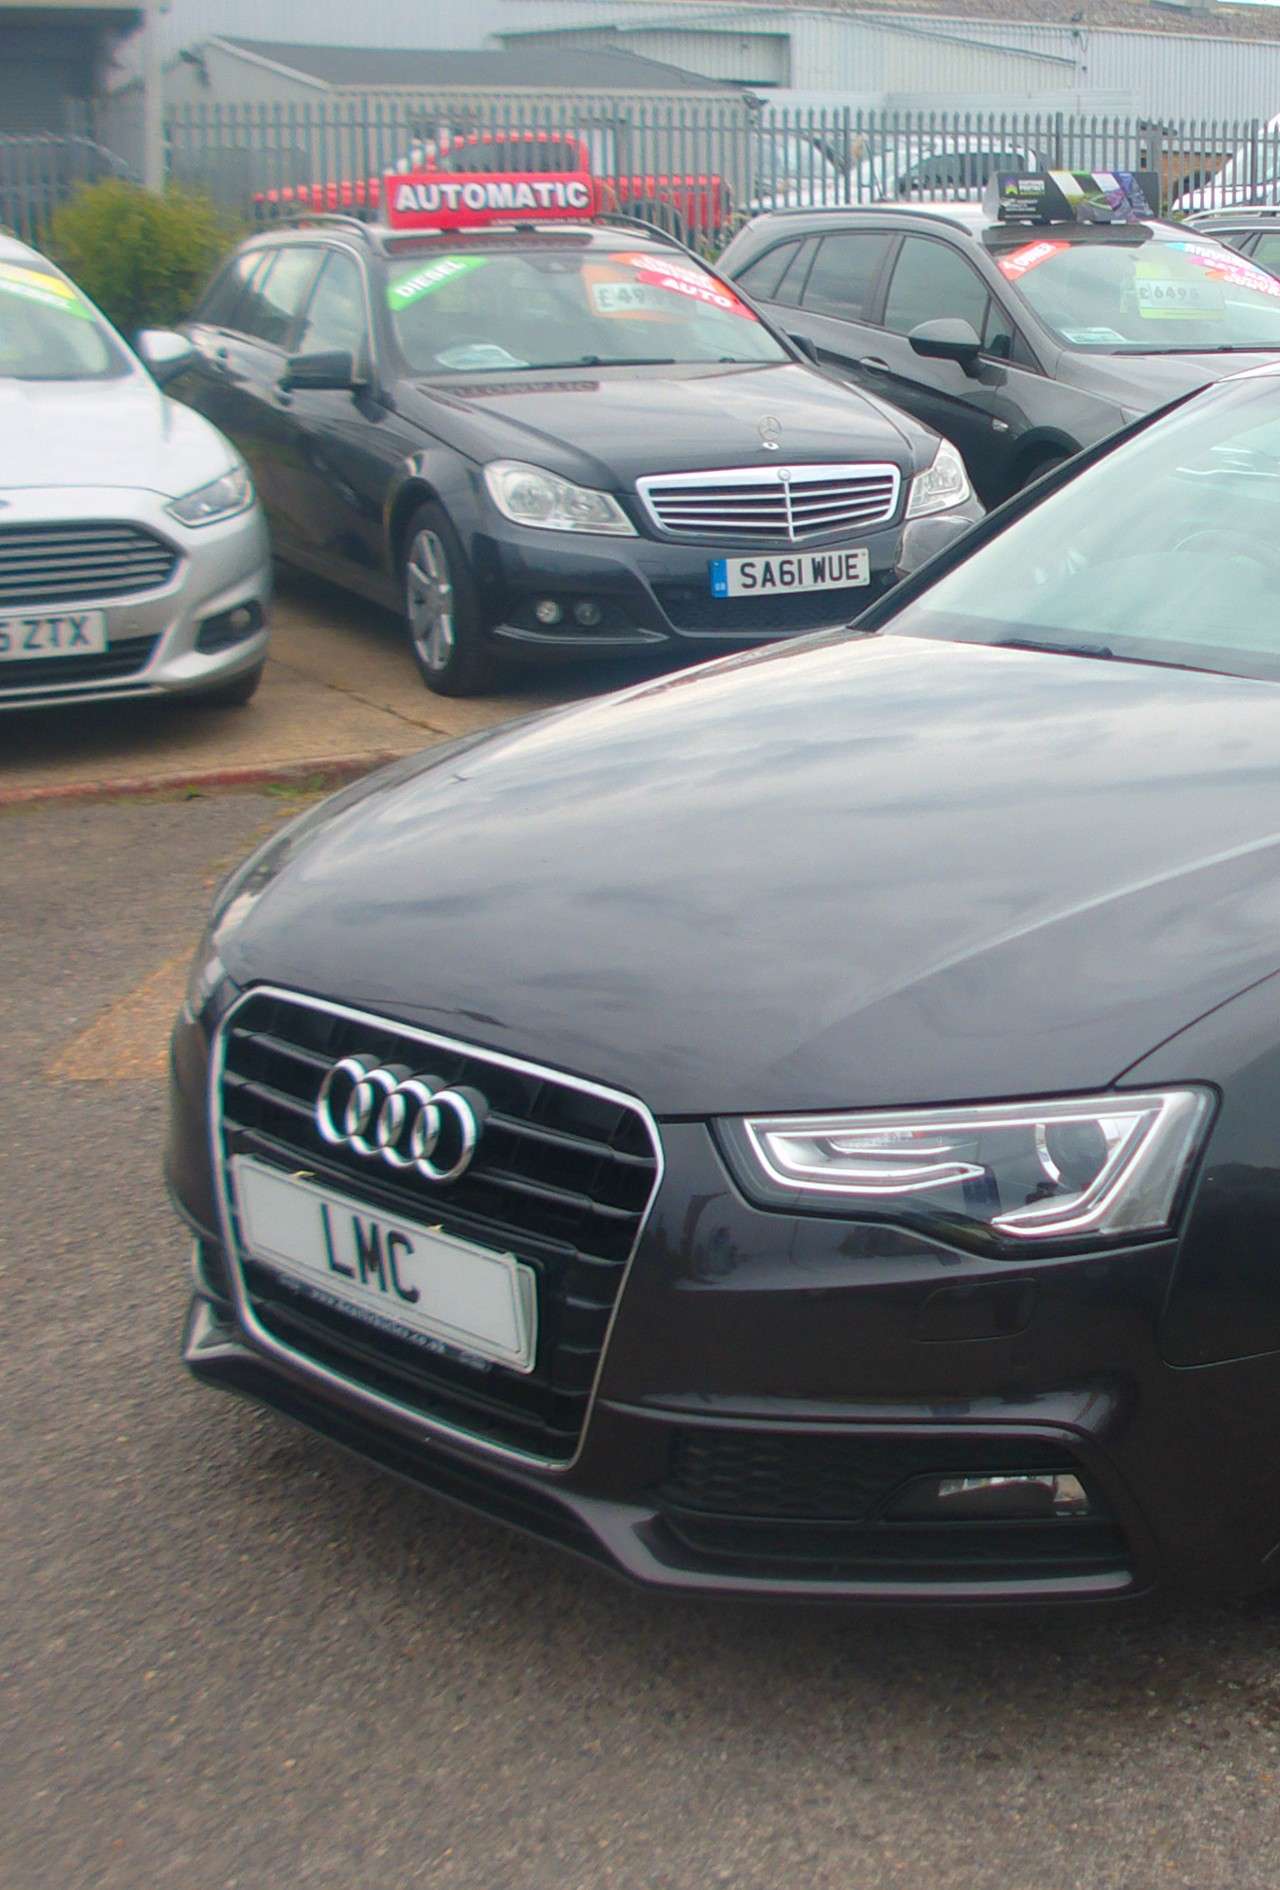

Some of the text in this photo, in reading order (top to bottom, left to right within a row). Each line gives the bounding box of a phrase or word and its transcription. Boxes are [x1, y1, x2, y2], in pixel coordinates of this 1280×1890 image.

[395, 181, 589, 211] AUTOMATIC
[662, 279, 733, 308] AUTO
[739, 553, 860, 590] SA61 WUE
[21, 615, 91, 651] ZTX
[320, 1202, 421, 1303] LMC
